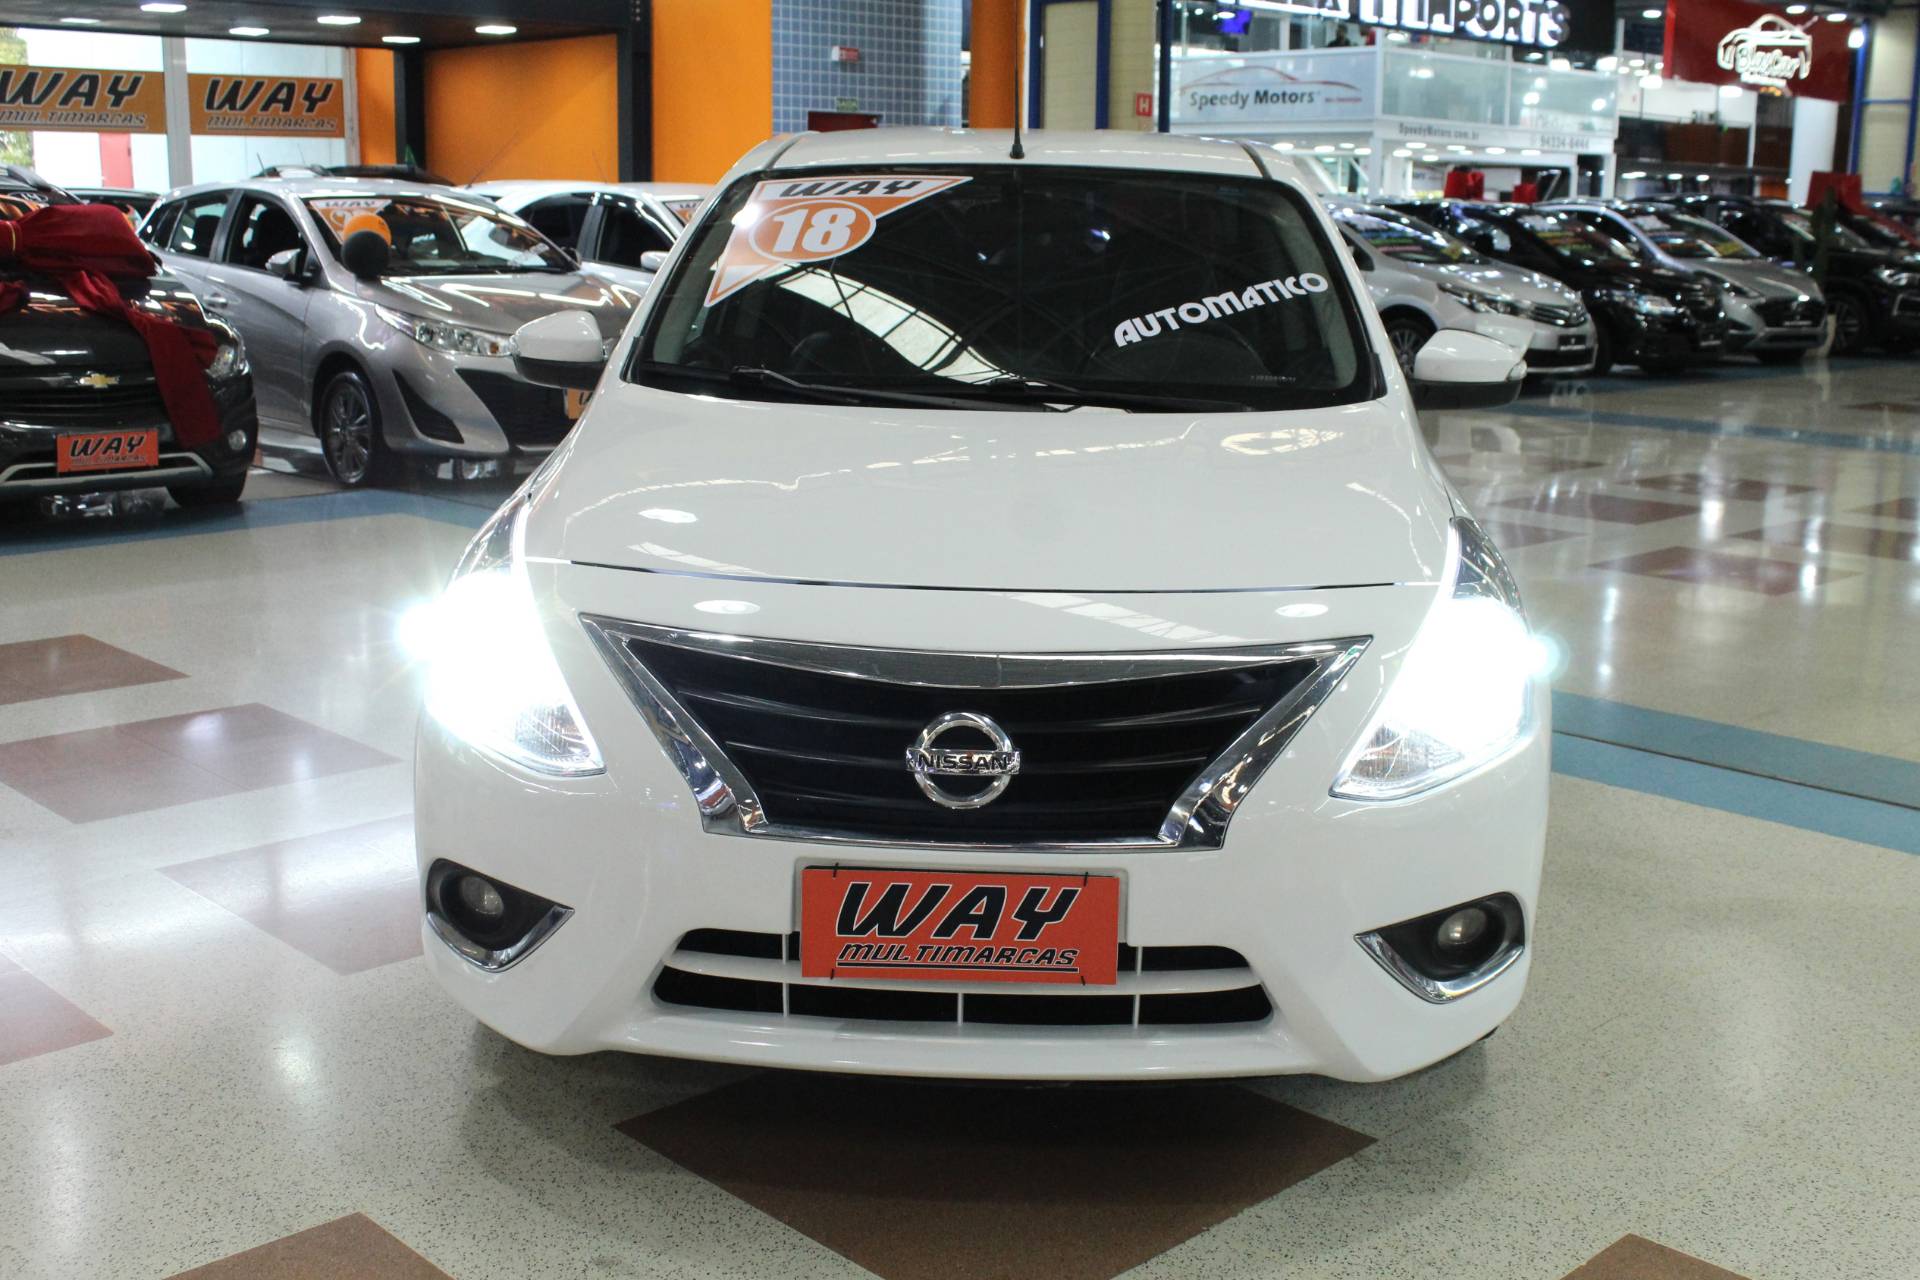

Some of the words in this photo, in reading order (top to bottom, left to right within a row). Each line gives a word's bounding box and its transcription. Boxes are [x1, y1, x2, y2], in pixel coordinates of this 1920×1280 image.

[0, 69, 145, 109] WAY
[204, 77, 336, 114] WAY
[1189, 90, 1249, 110] Speedy
[1254, 89, 1315, 105] Motors
[1139, 95, 1150, 113] H
[780, 180, 922, 198] WAY
[772, 207, 857, 254] 18
[1114, 272, 1329, 348] AUTOMATICO
[70, 435, 146, 457] WAY
[917, 752, 1012, 771] NISSAN
[836, 881, 1082, 942] WAY
[837, 943, 1080, 966] MULTIMARCAS
